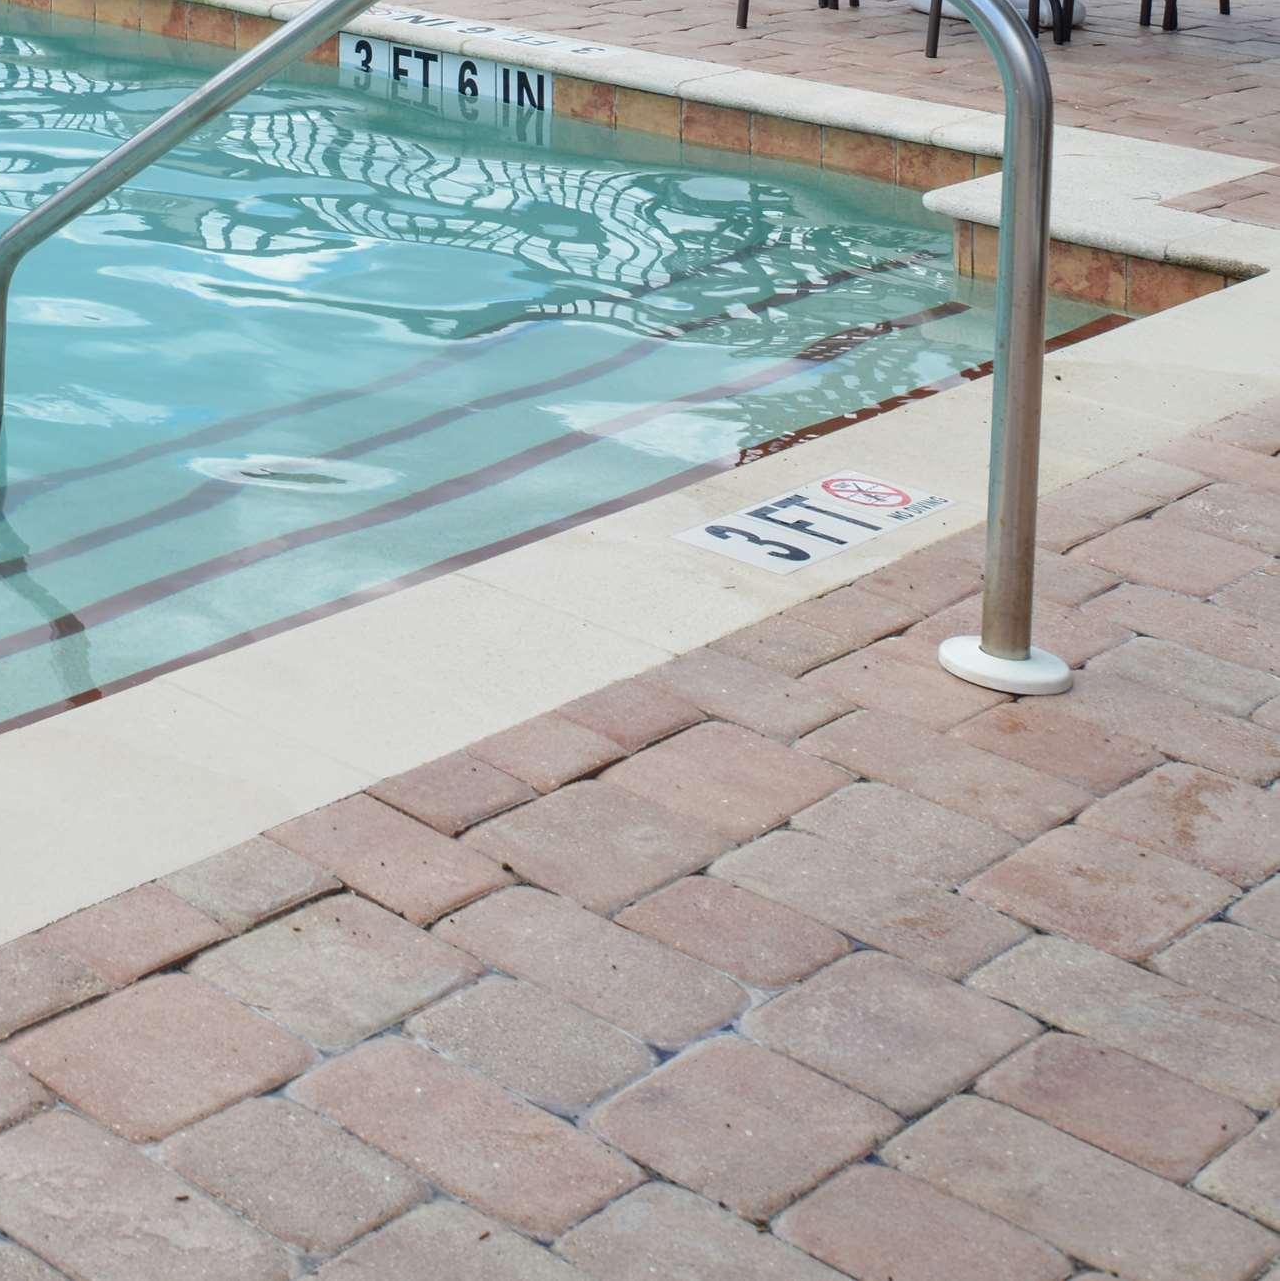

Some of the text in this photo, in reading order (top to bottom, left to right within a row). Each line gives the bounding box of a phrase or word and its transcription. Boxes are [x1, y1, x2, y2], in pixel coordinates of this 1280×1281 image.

[354, 39, 545, 112] 3 FT 6 IN
[704, 493, 883, 562] 3 FT
[886, 495, 949, 522] NO DIVING
